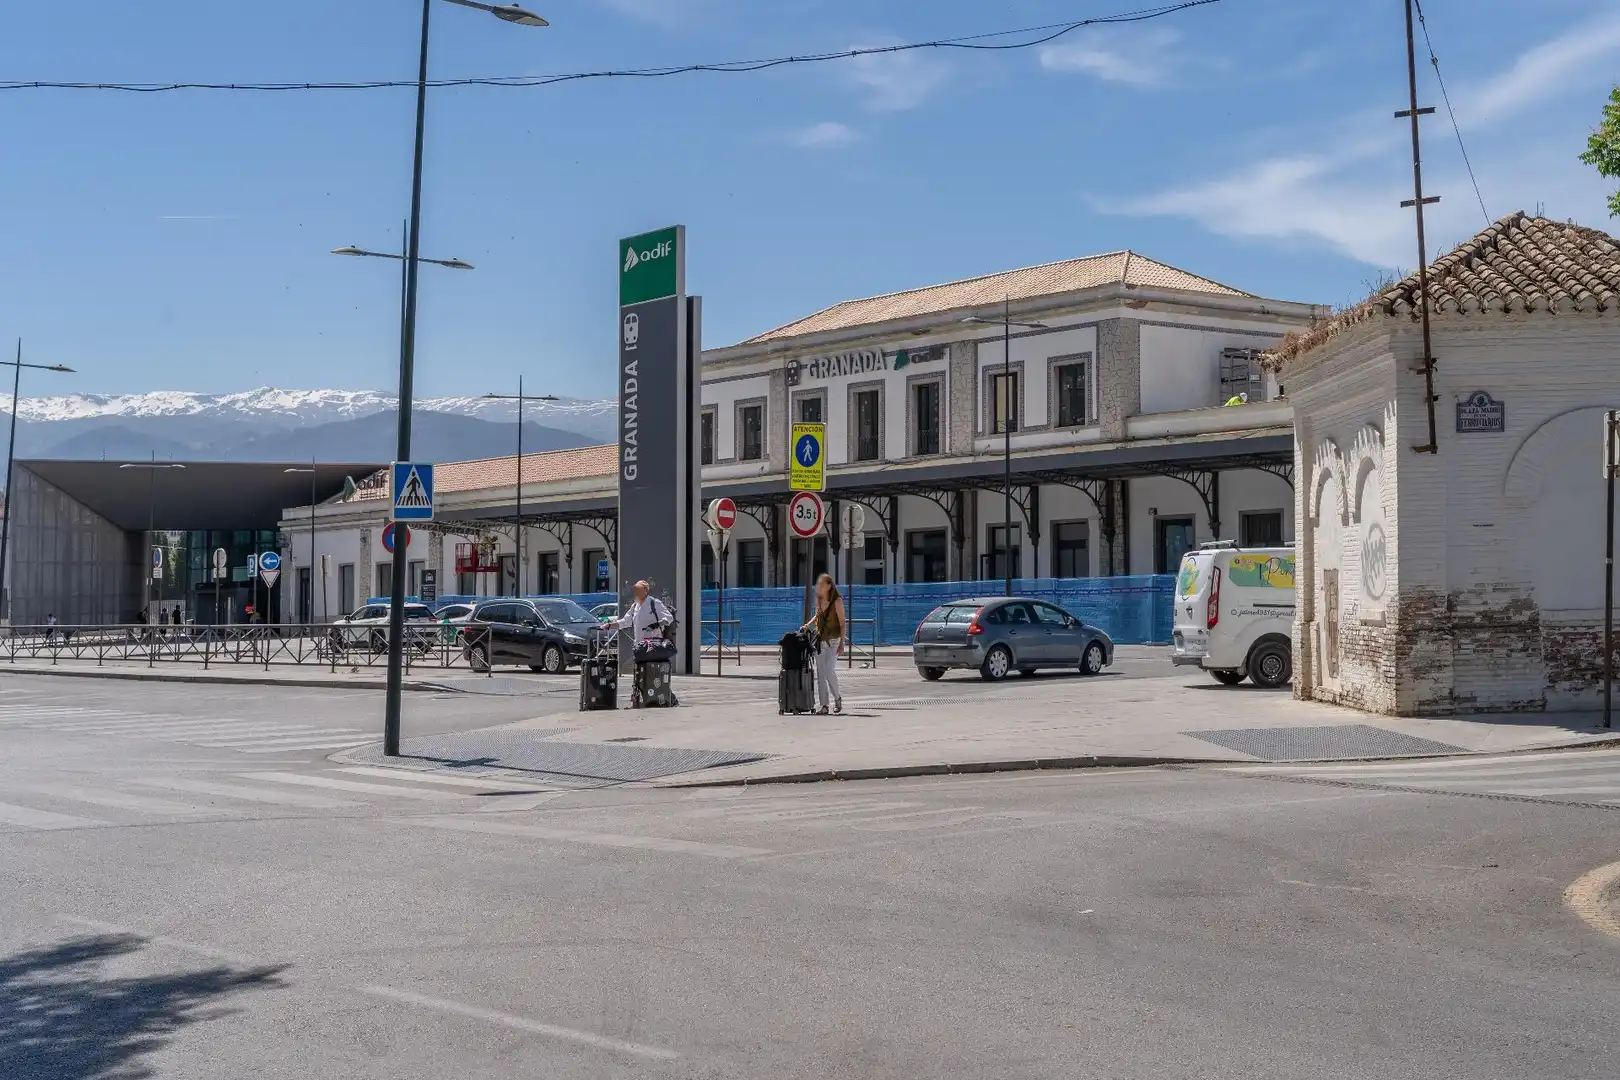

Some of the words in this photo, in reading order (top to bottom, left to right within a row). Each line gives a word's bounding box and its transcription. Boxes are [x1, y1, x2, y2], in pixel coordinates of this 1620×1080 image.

[640, 240, 672, 261] adif
[808, 349, 887, 379] GRANADA
[624, 359, 638, 481] GRANADA
[358, 471, 388, 489] adif
